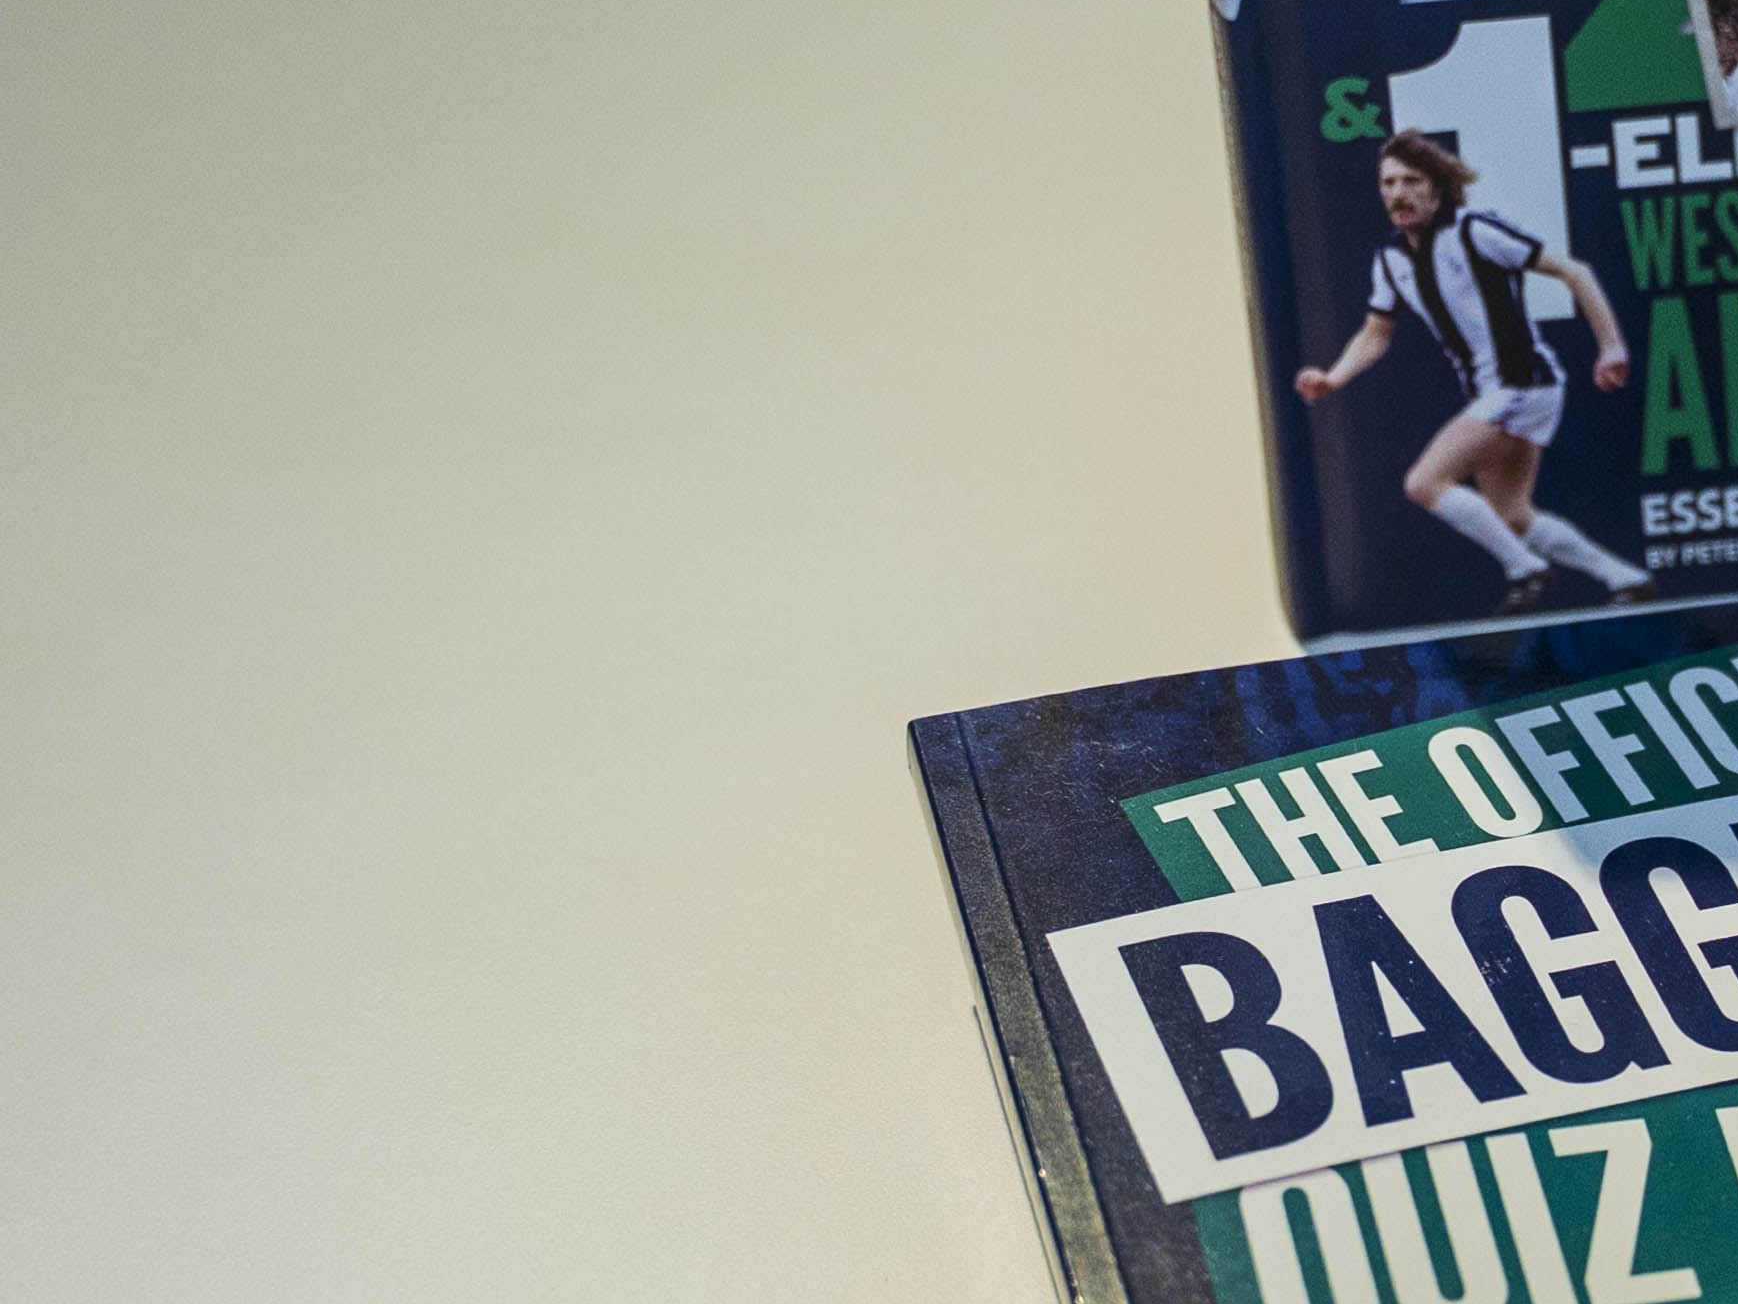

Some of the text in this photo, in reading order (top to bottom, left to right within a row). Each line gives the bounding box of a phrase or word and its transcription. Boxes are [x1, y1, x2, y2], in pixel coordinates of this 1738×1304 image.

[1319, 77, 1388, 140] &
[1645, 545, 1677, 569] BY
[1155, 748, 1435, 894] THE
